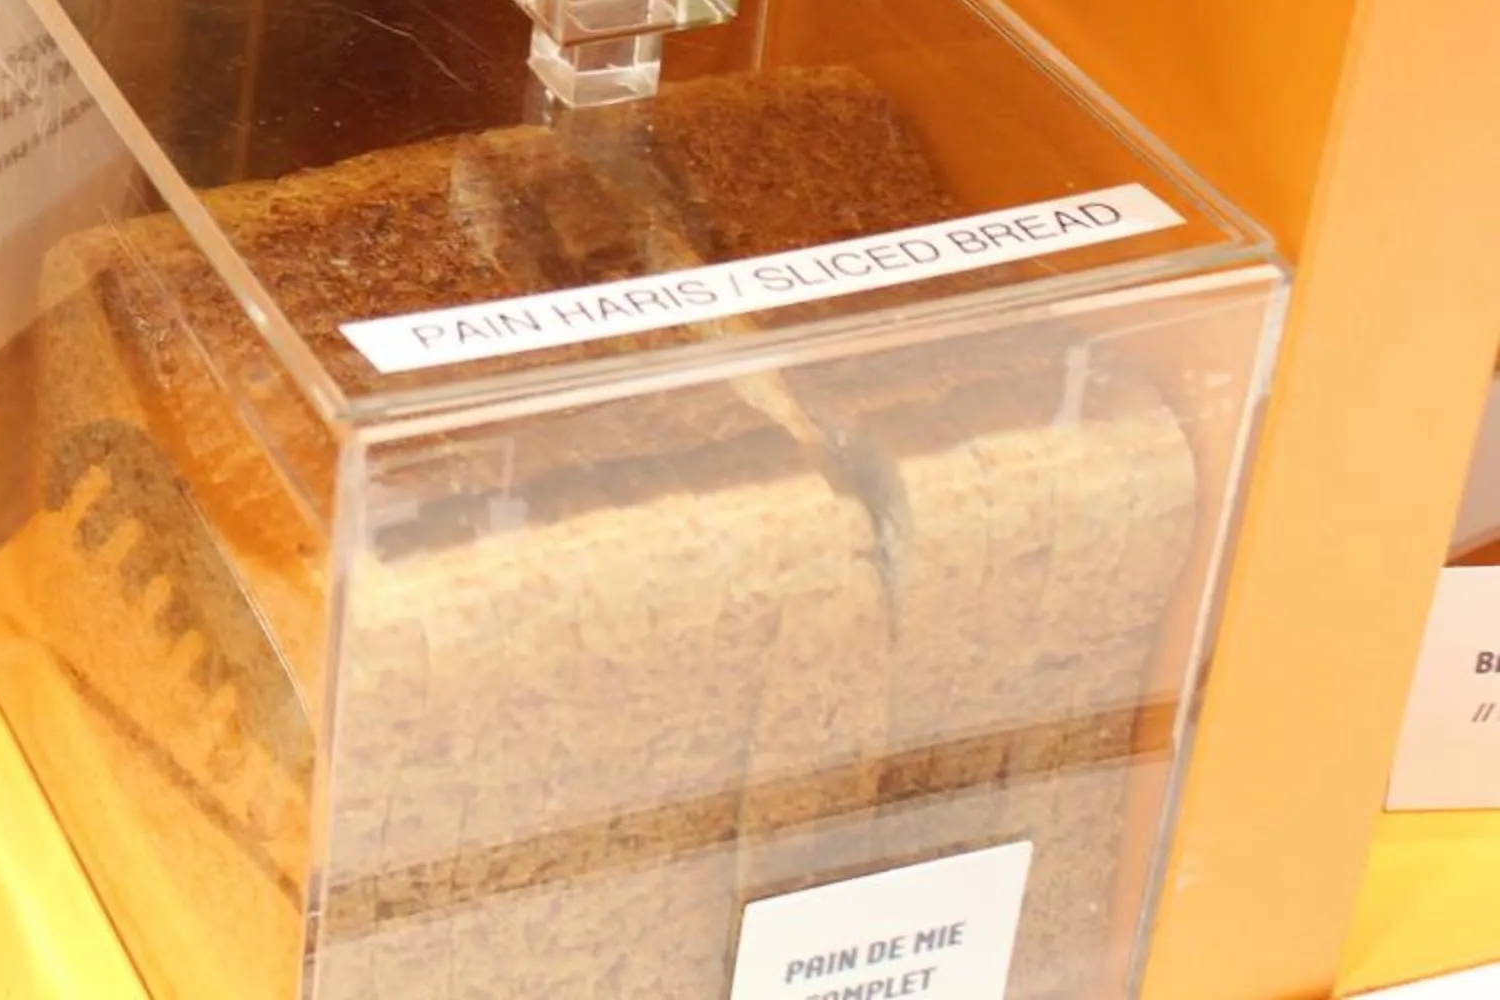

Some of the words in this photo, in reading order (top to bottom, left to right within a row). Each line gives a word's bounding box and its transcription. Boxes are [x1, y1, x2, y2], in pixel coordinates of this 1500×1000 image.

[411, 310, 541, 349] PAIN
[552, 280, 718, 326] HARIS
[729, 273, 743, 297] /
[754, 239, 940, 291] SLICED
[947, 202, 1122, 255] BREAD
[785, 947, 857, 984] PAIN
[866, 935, 906, 965] DE
[914, 921, 966, 955] MIE
